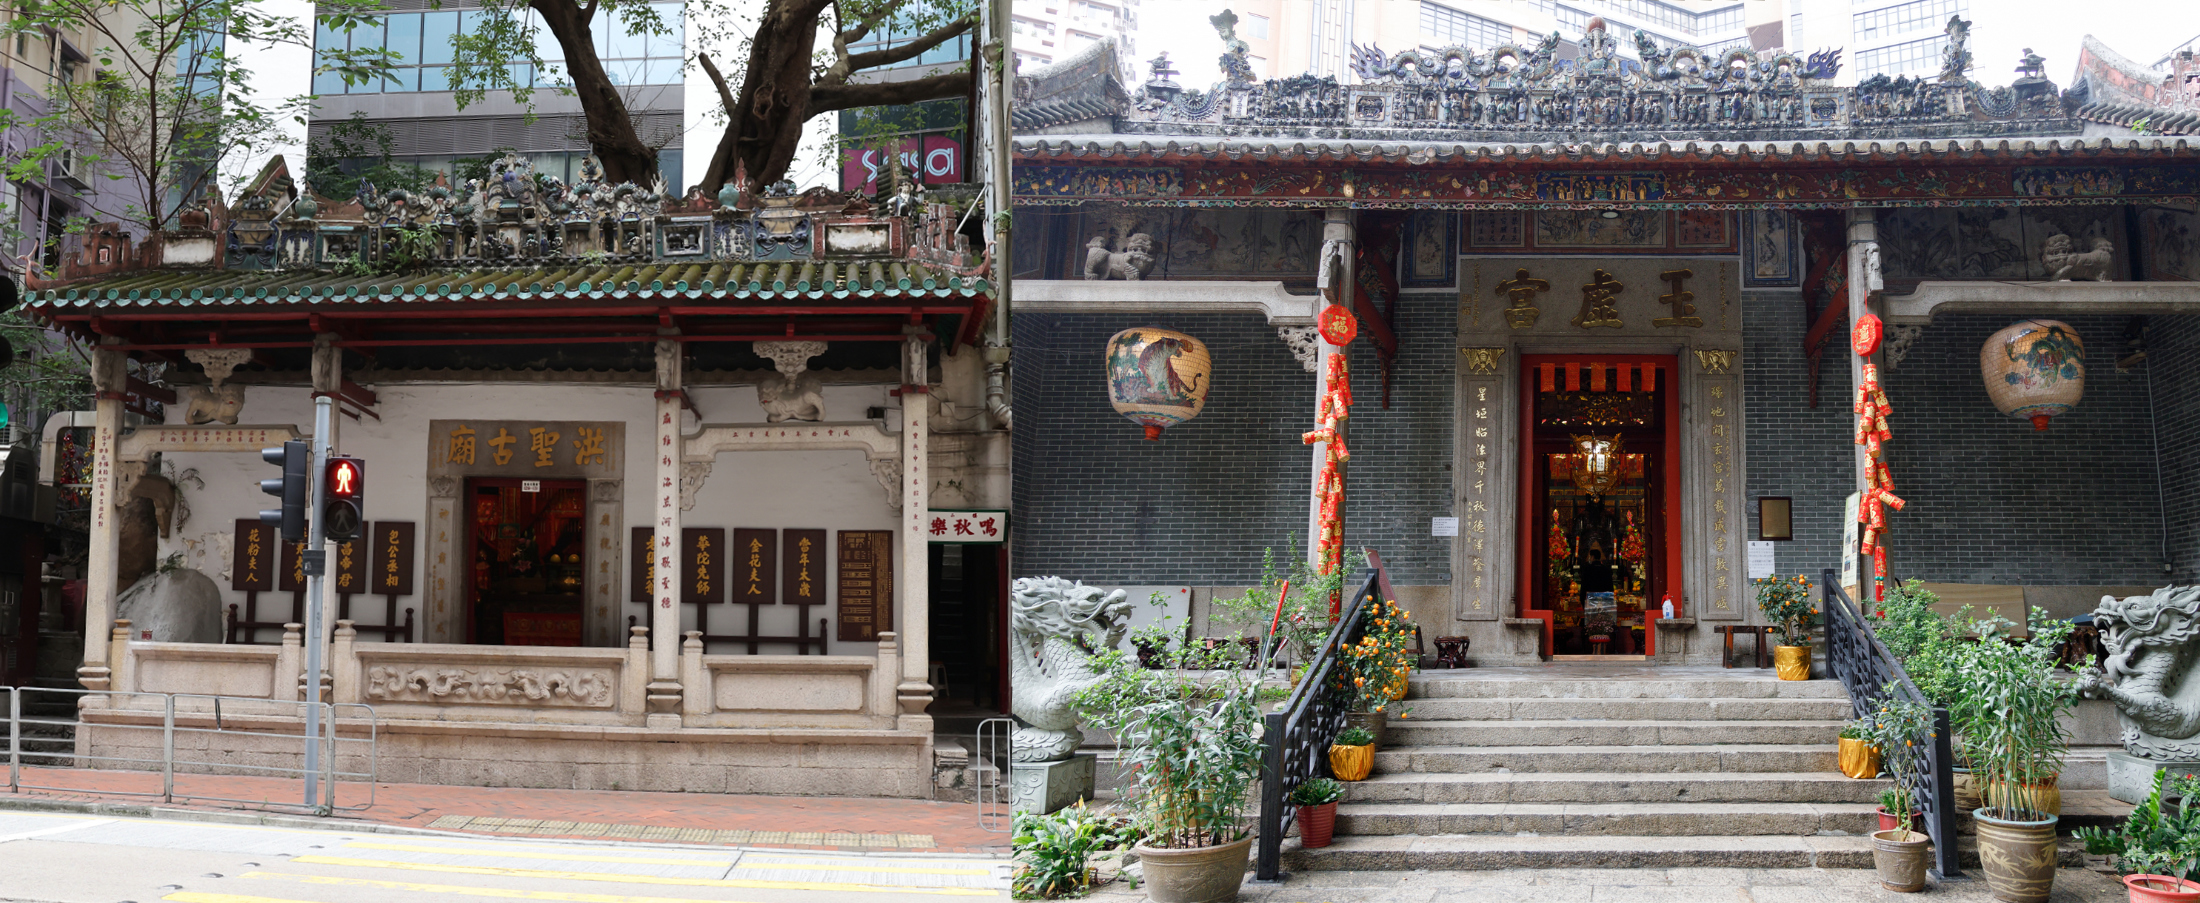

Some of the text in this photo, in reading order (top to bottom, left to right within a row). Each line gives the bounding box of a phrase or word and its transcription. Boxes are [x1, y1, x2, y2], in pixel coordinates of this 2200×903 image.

[1332, 315, 1348, 334] 福
[447, 424, 605, 468] 洪聖古廟
[929, 517, 998, 537] 鳴秋樂
[245, 528, 261, 583] 花粉夫人
[293, 528, 308, 585] 光大帝
[338, 541, 353, 587] 昌帝君
[747, 537, 763, 596] 金花夫人
